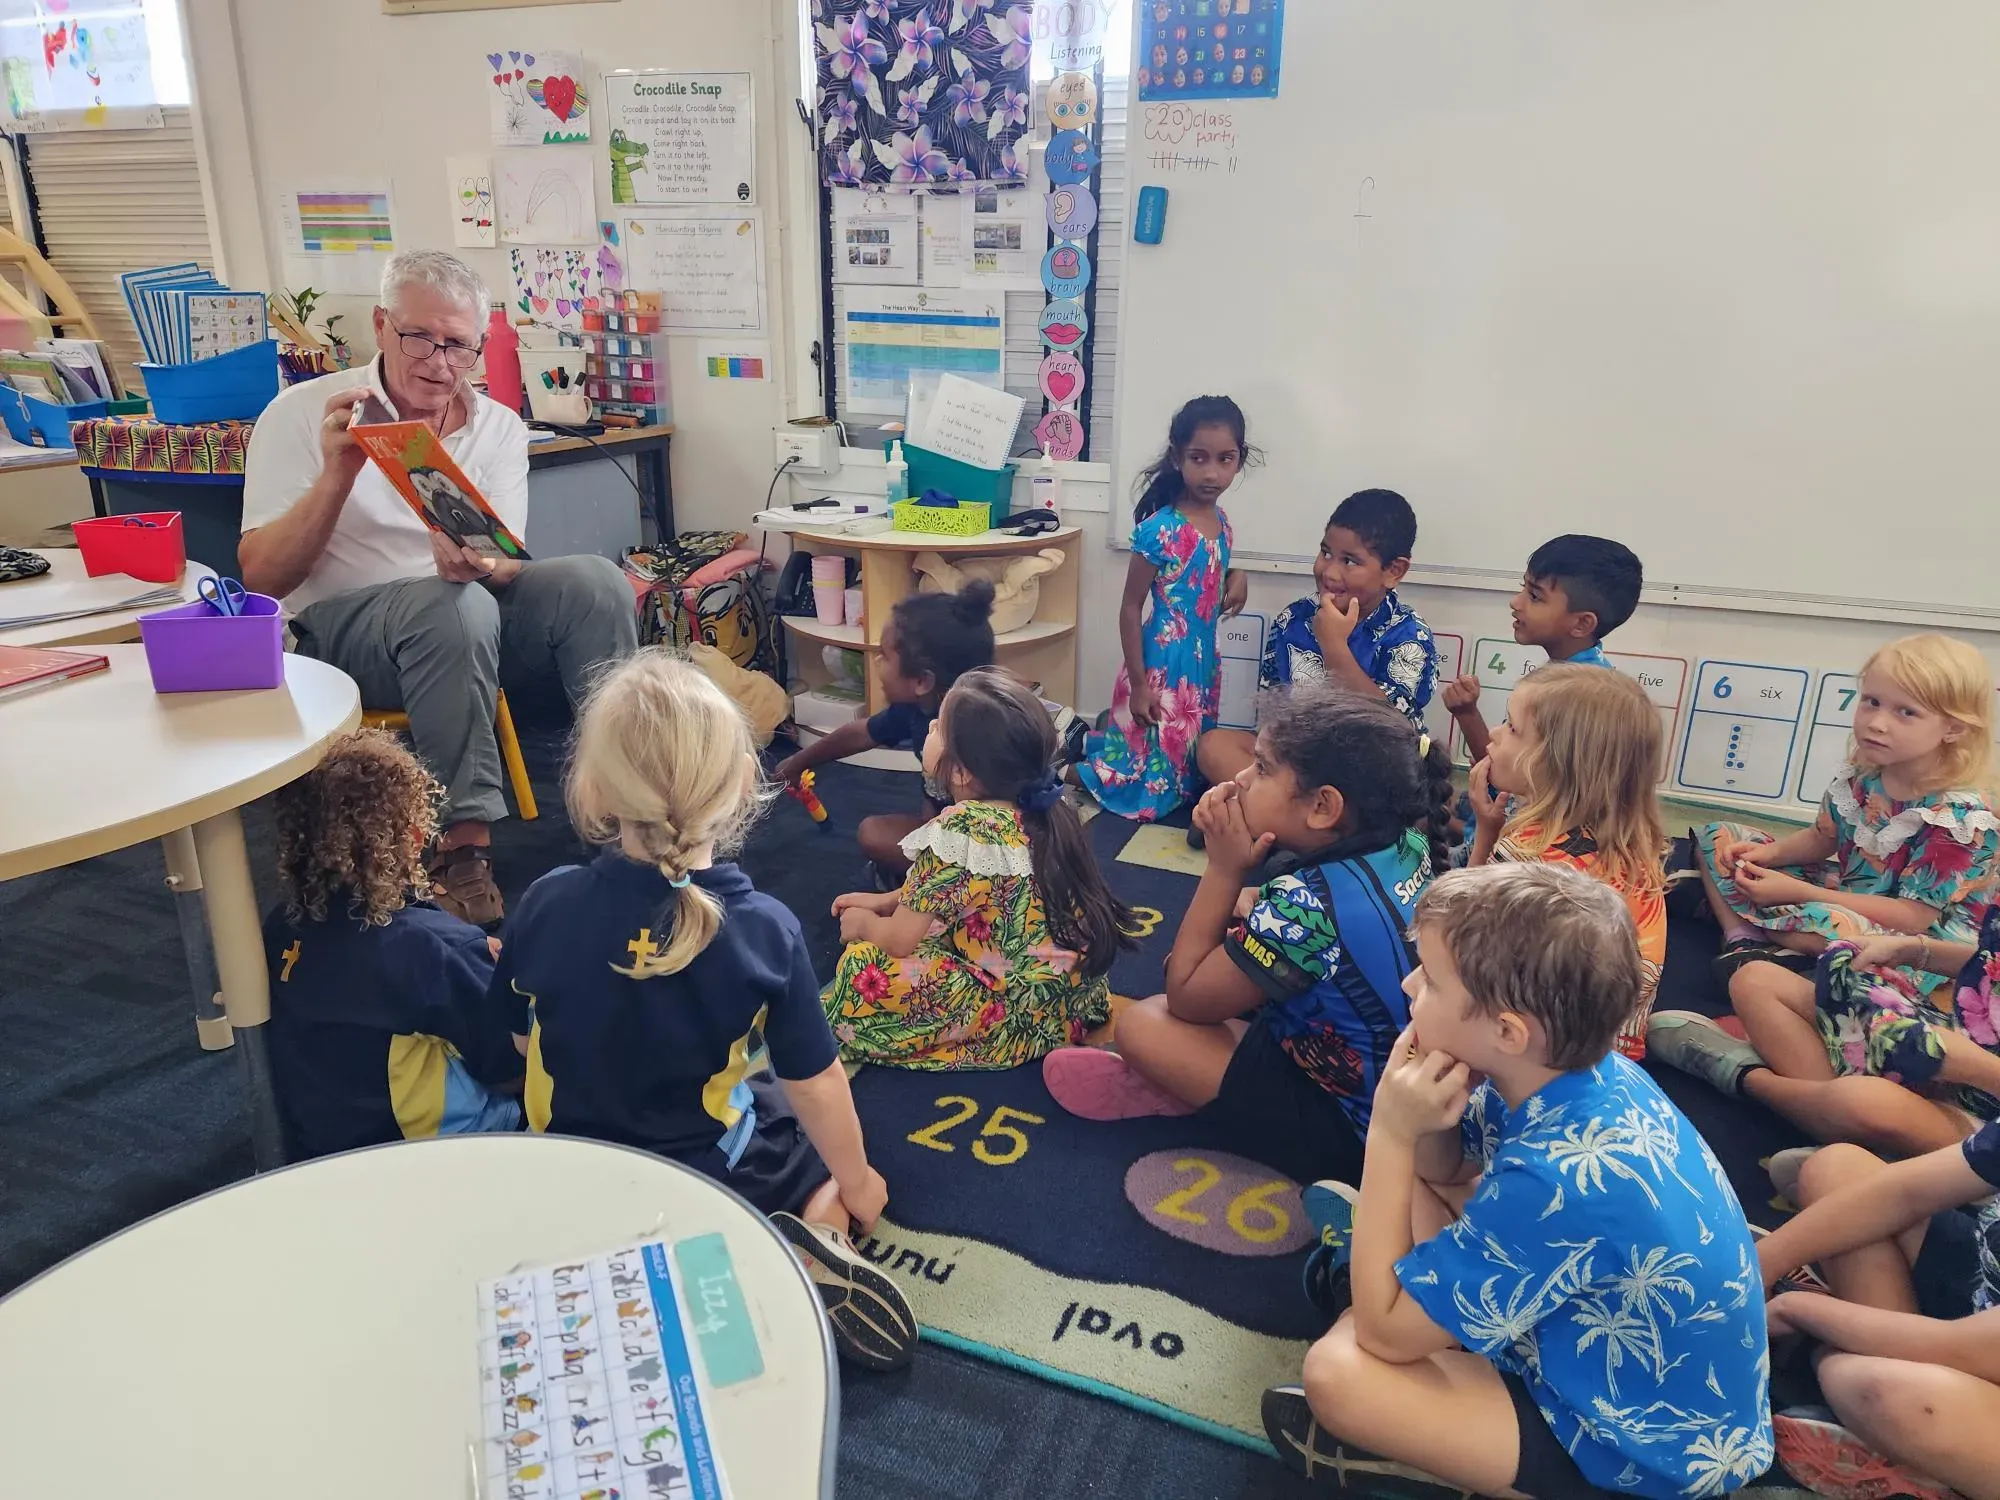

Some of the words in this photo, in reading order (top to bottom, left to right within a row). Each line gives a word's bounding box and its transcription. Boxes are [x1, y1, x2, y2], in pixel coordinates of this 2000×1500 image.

[1158, 30, 1166, 39] 13
[1197, 27, 1205, 37] 15
[1237, 25, 1245, 35] 17
[1050, 42, 1102, 60] Listening
[1234, 49, 1246, 59] 23
[1255, 48, 1265, 58] 24
[633, 82, 687, 96] Crocodile
[690, 82, 722, 99] Snap
[1060, 79, 1085, 100] eyes
[686, 104, 717, 112] Crocodile
[667, 116, 679, 124] and
[681, 117, 692, 126] lay
[1158, 107, 1184, 126] 20
[1193, 108, 1232, 128] class
[655, 128, 672, 136] Crawl
[675, 128, 690, 138] right
[1196, 130, 1235, 148] party
[653, 140, 669, 148] Come
[672, 140, 688, 149] right
[653, 151, 666, 159] Turn
[683, 151, 694, 159] the
[1044, 148, 1074, 168] body
[658, 174, 672, 182] Now
[657, 185, 663, 193] To
[1062, 223, 1087, 233] ears
[1050, 280, 1080, 293] brain
[1045, 308, 1081, 321] mouth
[1048, 356, 1077, 371] heart
[1227, 631, 1249, 642] one
[1487, 653, 1506, 675] 4
[1637, 672, 1664, 687] five
[1713, 675, 1733, 699] 6
[1760, 687, 1784, 700] six
[1838, 688, 1857, 711] 7
[1394, 848, 1432, 906] Sacred
[1243, 933, 1277, 968] WAS
[906, 1095, 1046, 1166] 25
[1154, 1157, 1291, 1244] 26
[608, 1262, 626, 1272] a
[553, 1276, 572, 1287] n
[613, 1286, 646, 1299] b
[557, 1304, 575, 1313] o
[695, 1269, 733, 1335] Izzy
[619, 1319, 638, 1329] c
[1052, 1301, 1186, 1359] oval
[543, 1331, 579, 1343] p
[624, 1345, 660, 1362] d
[501, 1381, 516, 1395] ss
[630, 1383, 649, 1393] e
[679, 1374, 692, 1394] Our
[568, 1396, 588, 1408] r
[503, 1411, 519, 1432] zz
[635, 1411, 674, 1421] f
[683, 1394, 701, 1436] Sounds
[573, 1435, 594, 1446] s
[692, 1437, 709, 1459] and
[506, 1448, 535, 1468] sh
[623, 1450, 663, 1466] g
[577, 1468, 606, 1481] t
